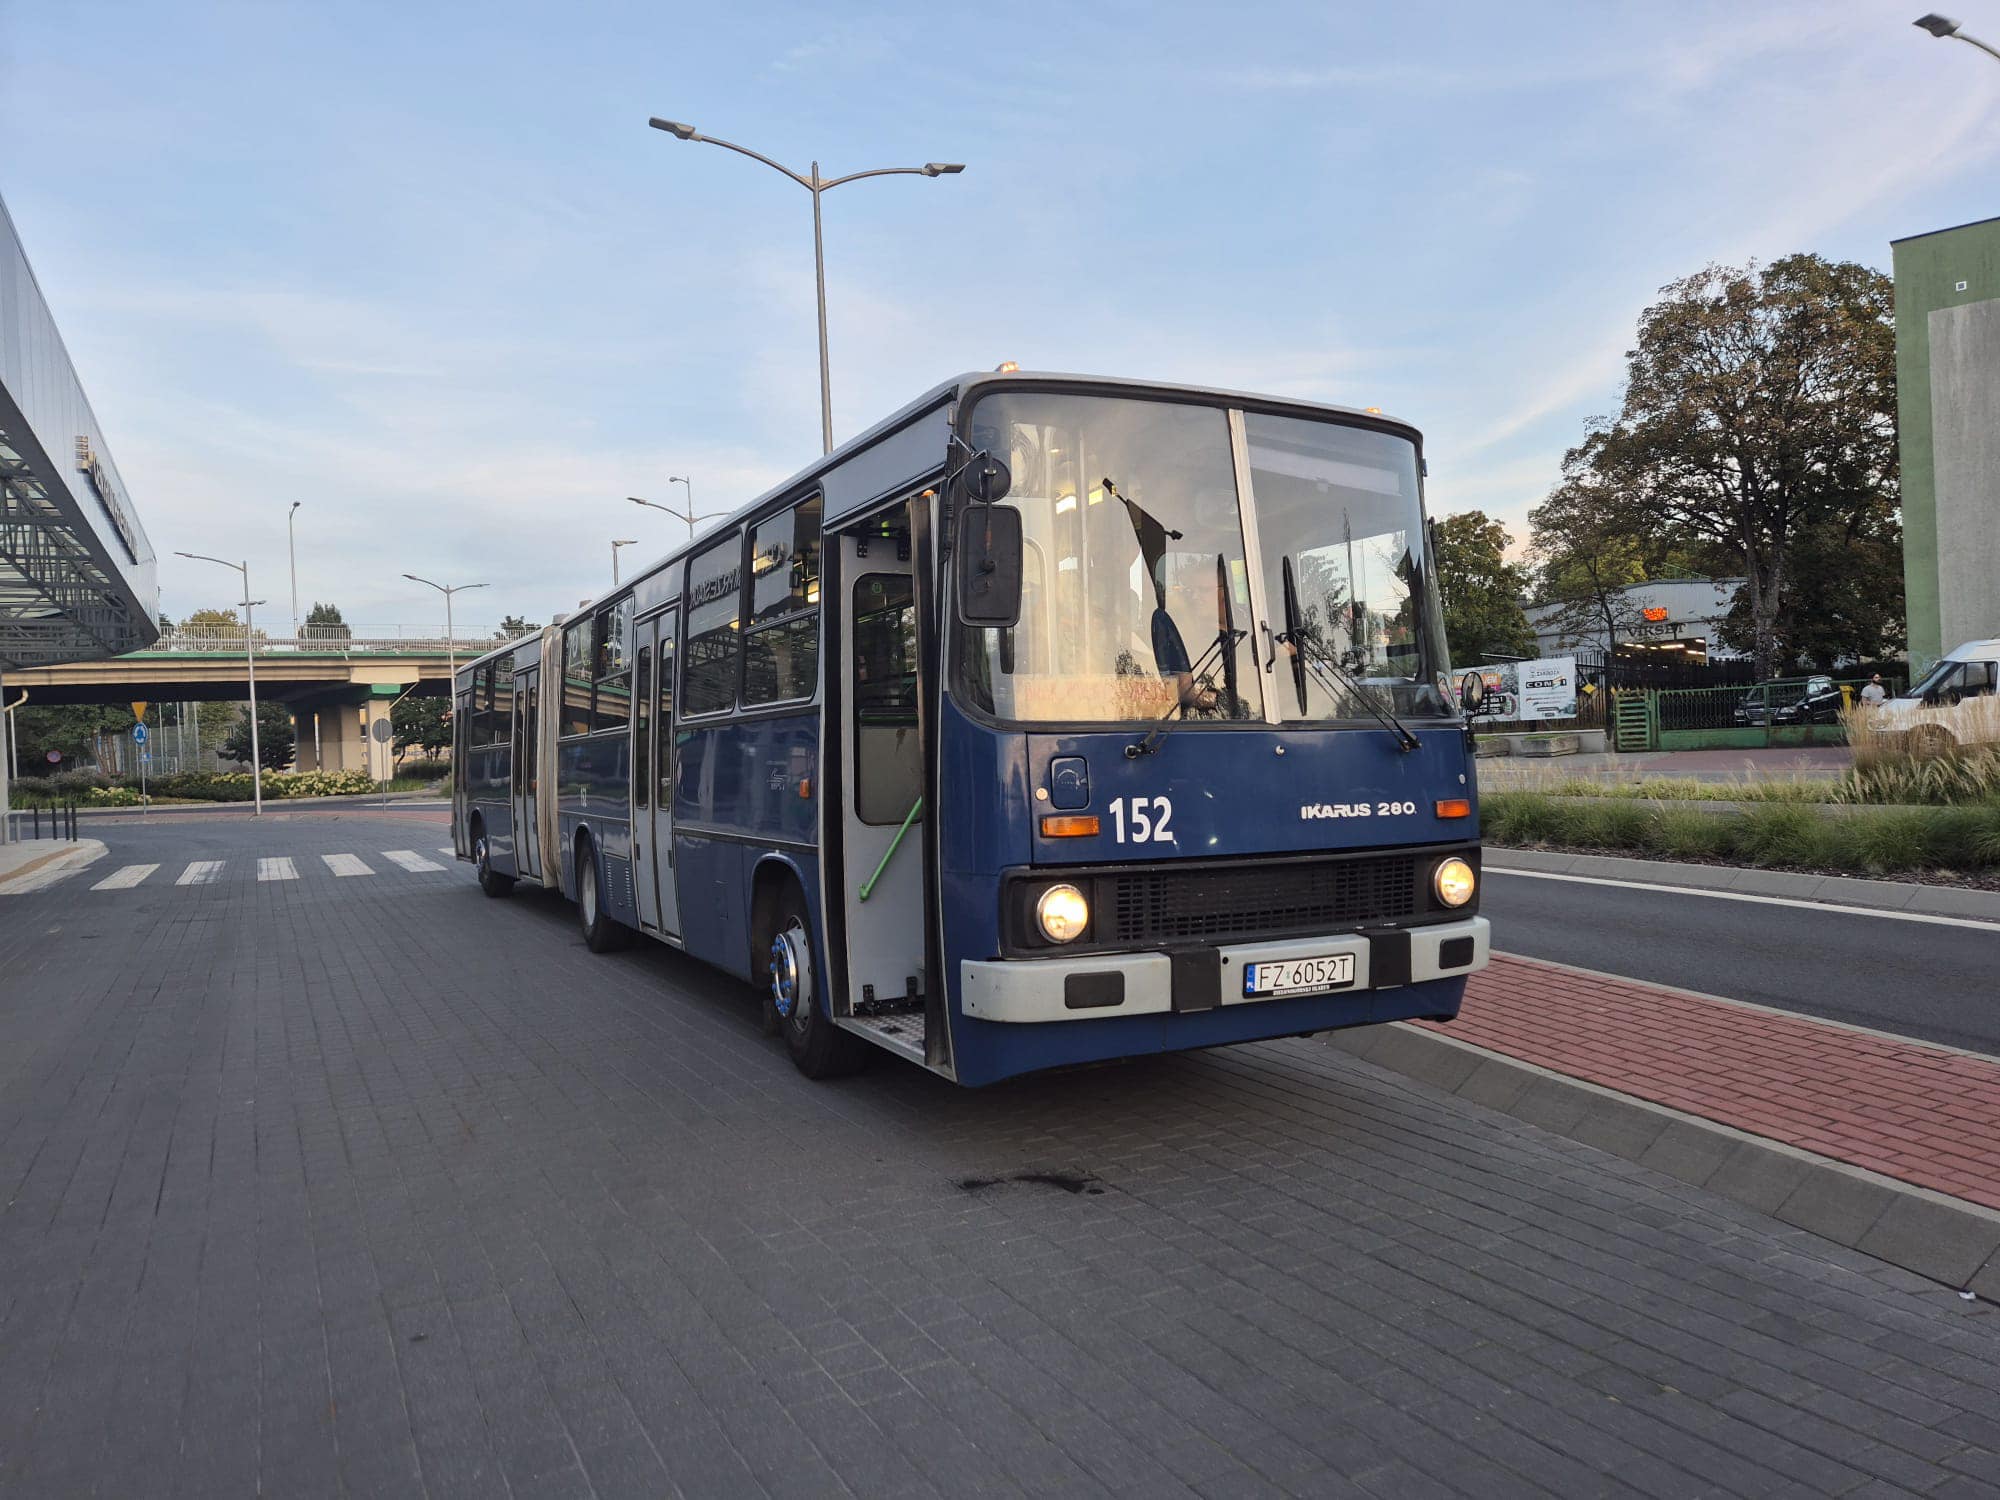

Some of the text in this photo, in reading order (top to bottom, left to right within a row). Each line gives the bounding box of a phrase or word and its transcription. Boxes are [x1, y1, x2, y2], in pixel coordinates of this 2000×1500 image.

[1109, 796, 1173, 843] 152
[1301, 801, 1416, 820] IKARUS 280
[1259, 957, 1349, 989] FZ 6052T
